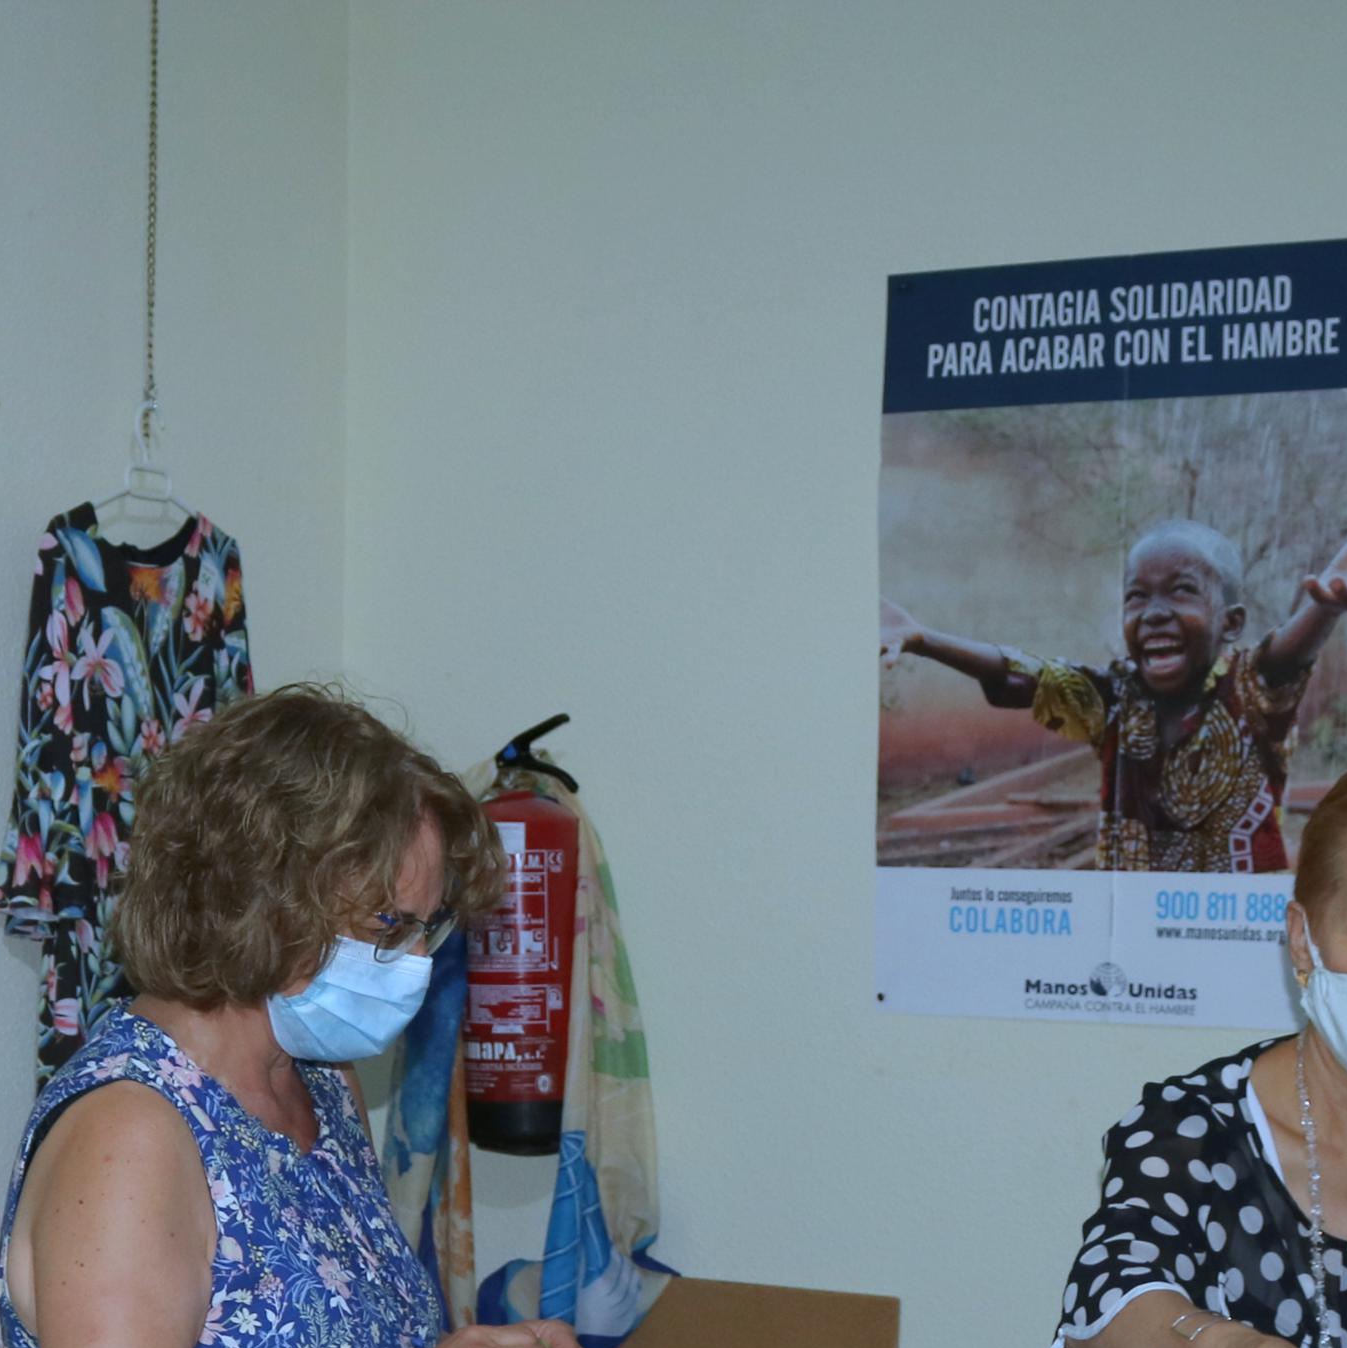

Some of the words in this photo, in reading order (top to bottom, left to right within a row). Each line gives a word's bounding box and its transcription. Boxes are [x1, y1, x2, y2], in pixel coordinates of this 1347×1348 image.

[973, 288, 1101, 333] CONTAGIA
[1109, 274, 1292, 323] SOLIDARIDAD
[927, 340, 993, 379] PARA
[1000, 332, 1106, 374] ACABAR
[1114, 327, 1170, 367] CON
[1181, 325, 1213, 363] EL
[1222, 317, 1341, 361] HAMBRE
[951, 887, 982, 901] Juntos
[998, 889, 1073, 905] conseguiremos
[1156, 890, 1199, 920] 900
[1207, 892, 1237, 921] 811
[1246, 893, 1287, 922] 888
[949, 905, 1072, 935] COLABORA
[1156, 927, 1287, 946] www.manosunidas.org
[1024, 979, 1088, 996] Manos
[1128, 983, 1197, 1000] Unidas
[1024, 998, 1081, 1011] CAMPAÑA
[1084, 1000, 1133, 1014] CONTRA
[1135, 1002, 1147, 1014] EL
[1149, 1003, 1196, 1016] HAMBRE
